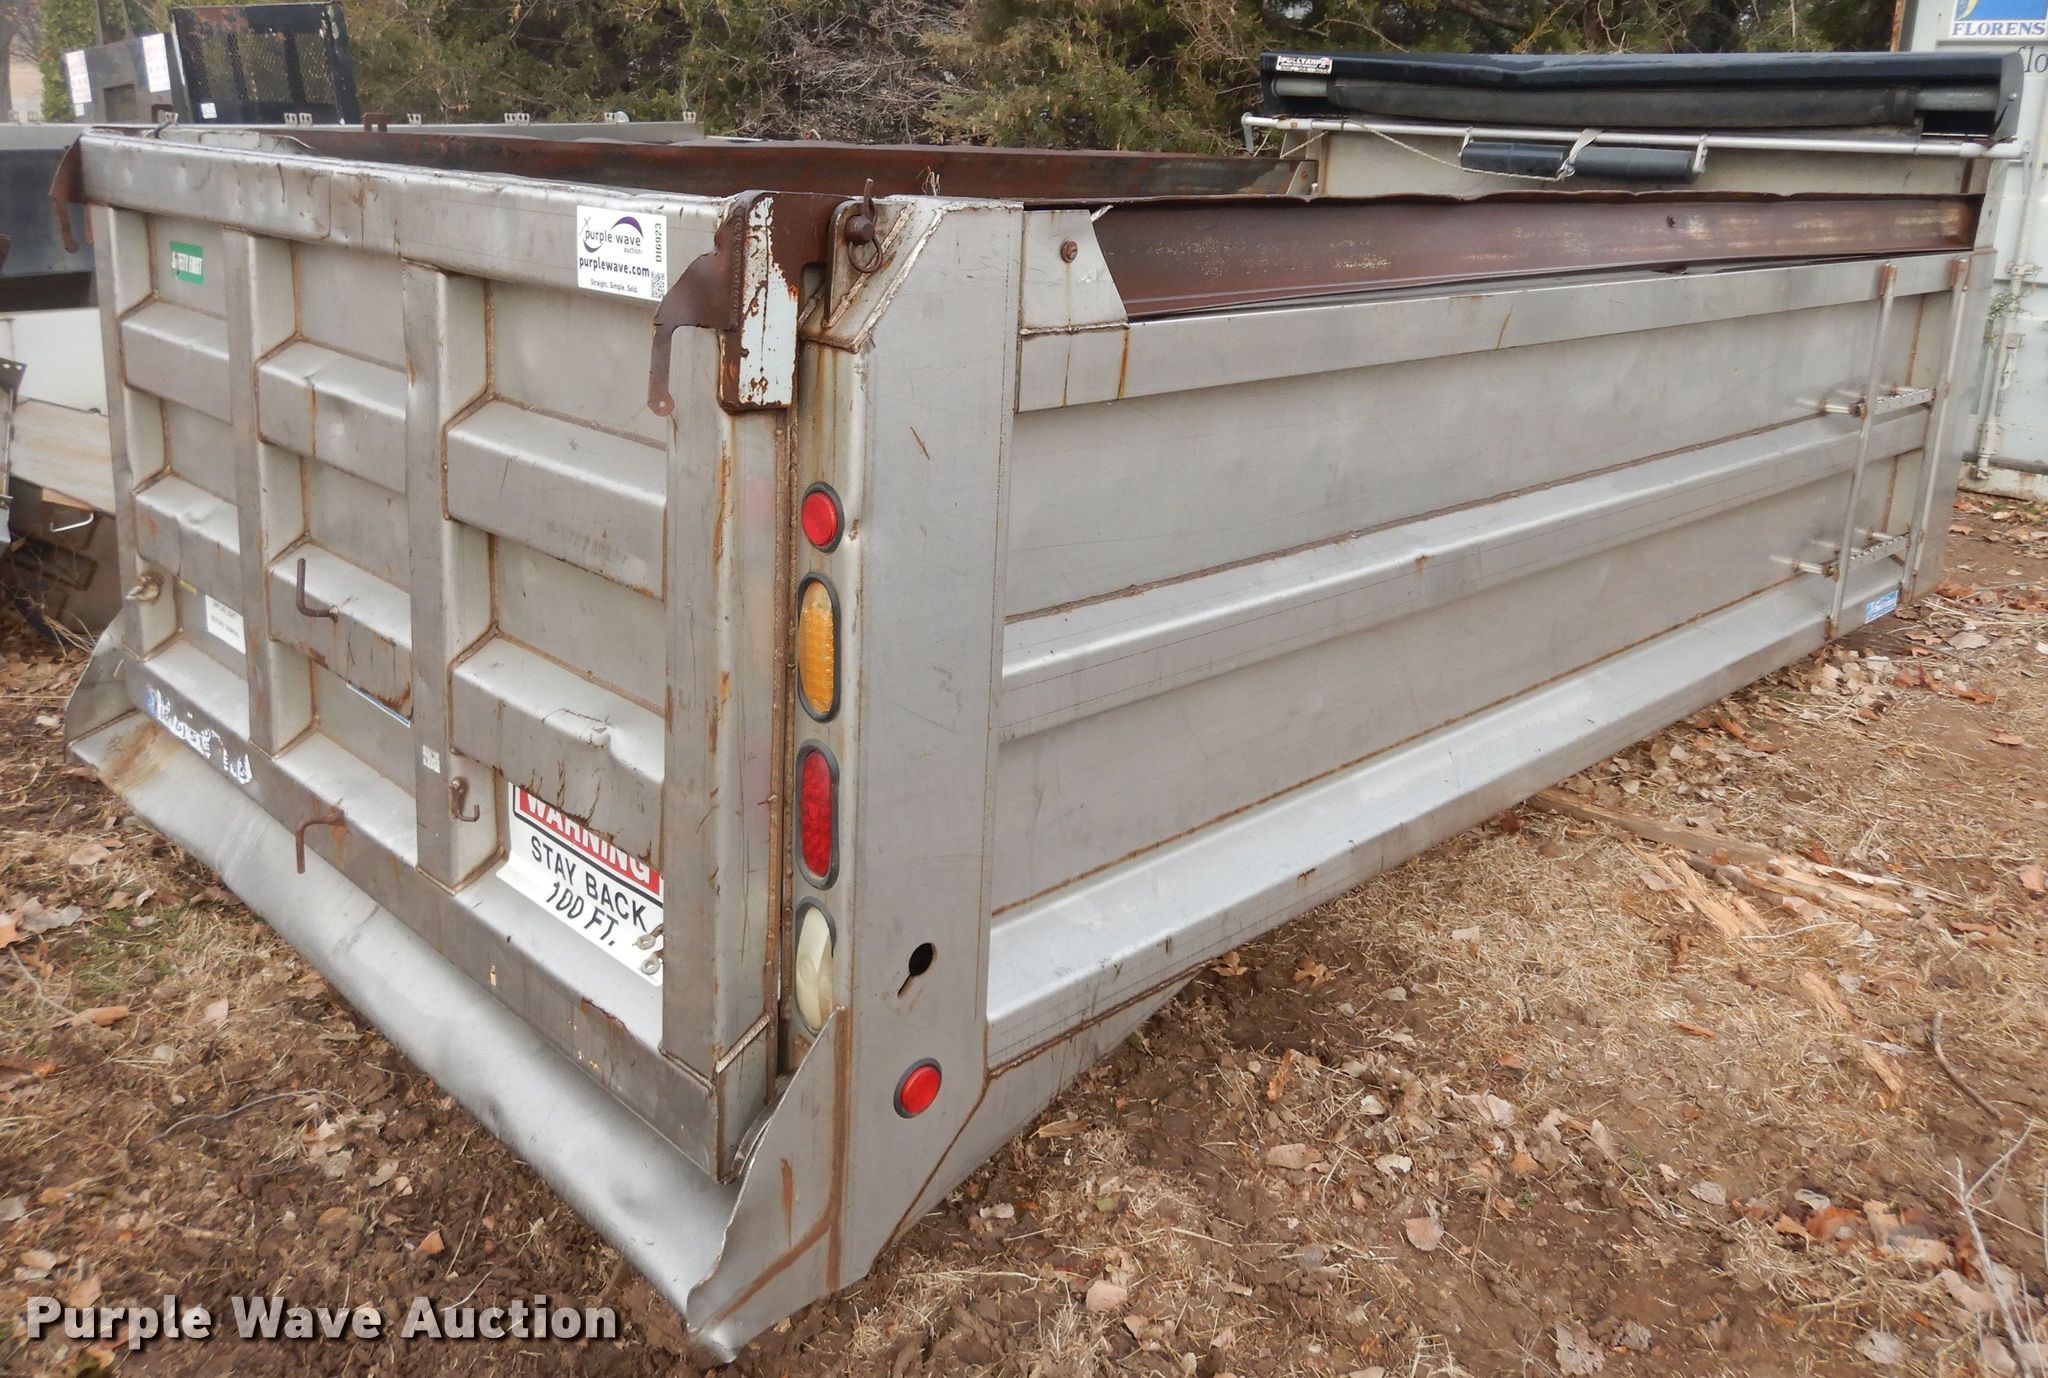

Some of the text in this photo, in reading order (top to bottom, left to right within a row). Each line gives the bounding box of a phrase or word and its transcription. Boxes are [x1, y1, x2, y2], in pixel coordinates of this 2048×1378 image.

[1951, 22, 2045, 36] FLORENS
[584, 230, 641, 247] purple wave
[655, 223, 663, 263] DI6923
[579, 256, 650, 278] purplewave.com
[531, 835, 648, 932] STAY BACK
[584, 905, 620, 947] FT.
